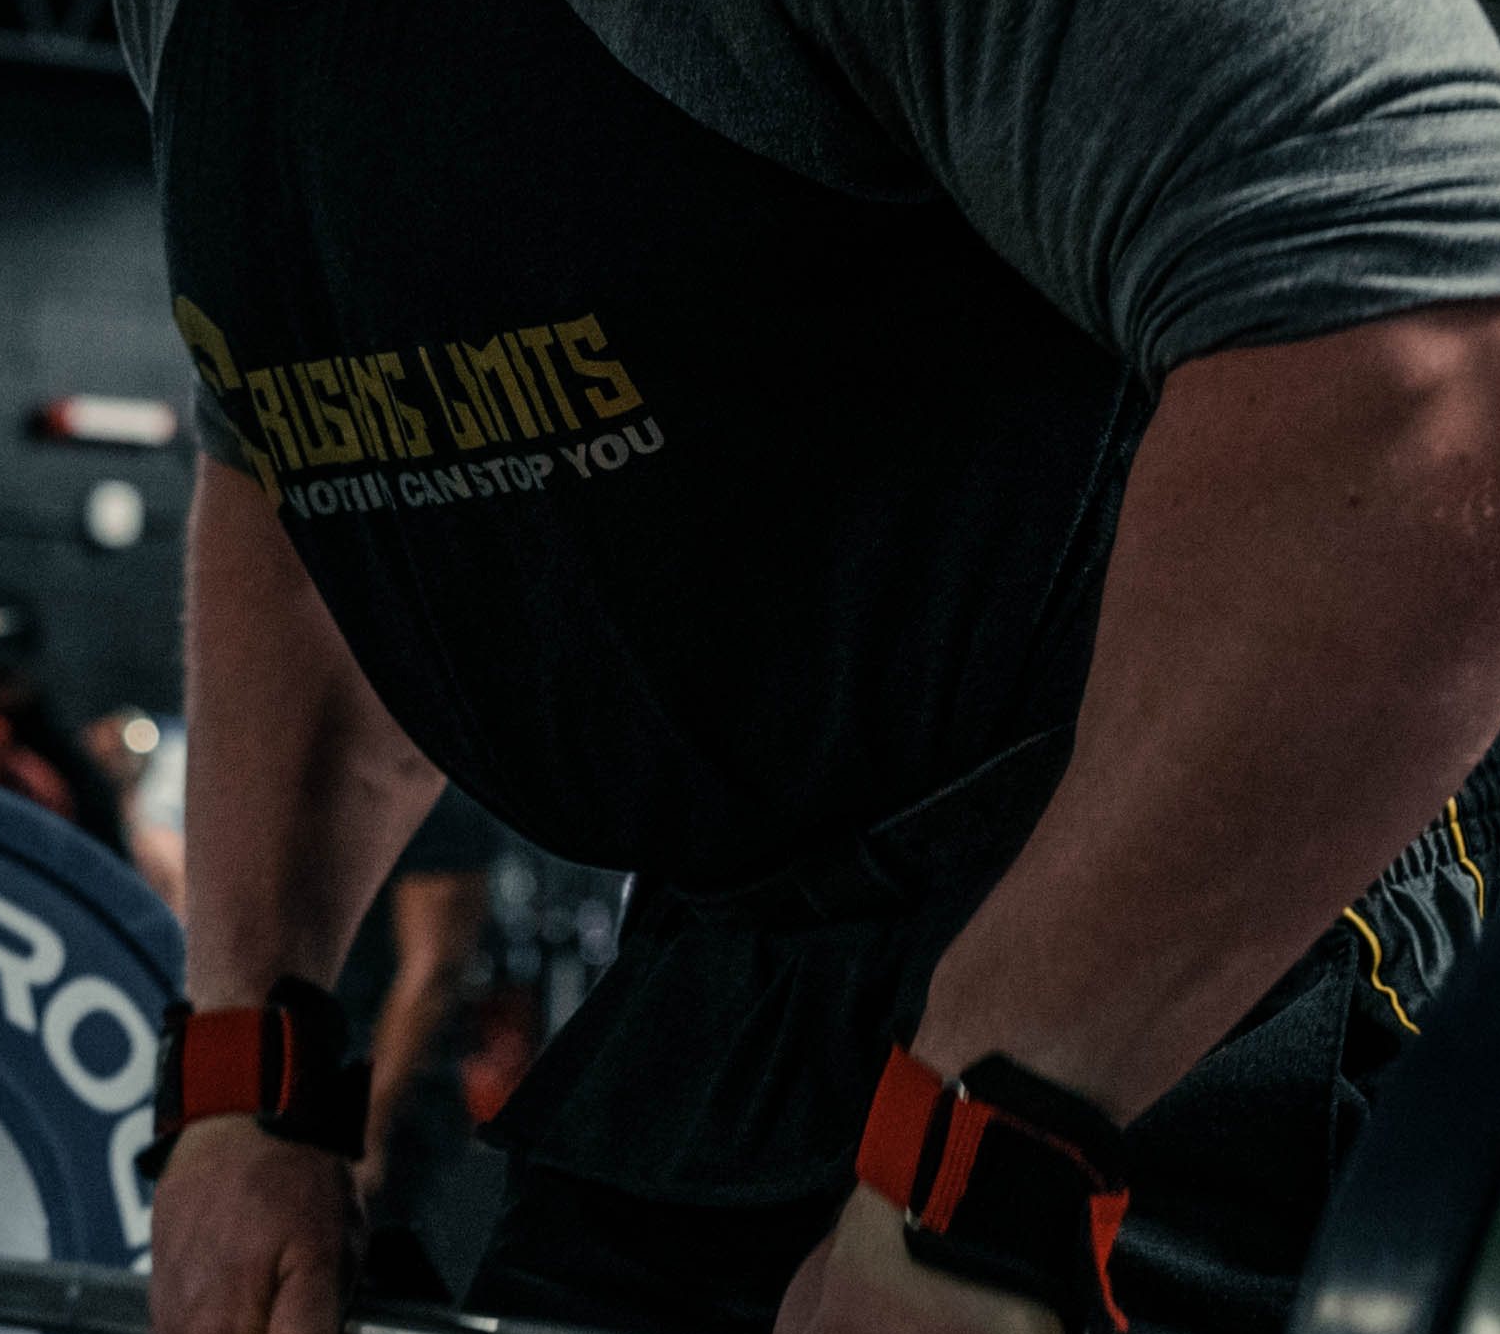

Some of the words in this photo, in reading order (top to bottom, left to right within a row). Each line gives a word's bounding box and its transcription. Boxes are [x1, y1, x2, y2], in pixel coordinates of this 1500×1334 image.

[417, 314, 645, 451] LIMITS
[399, 464, 473, 508] CAN
[467, 453, 554, 498] STOP
[559, 416, 665, 479] YOU
